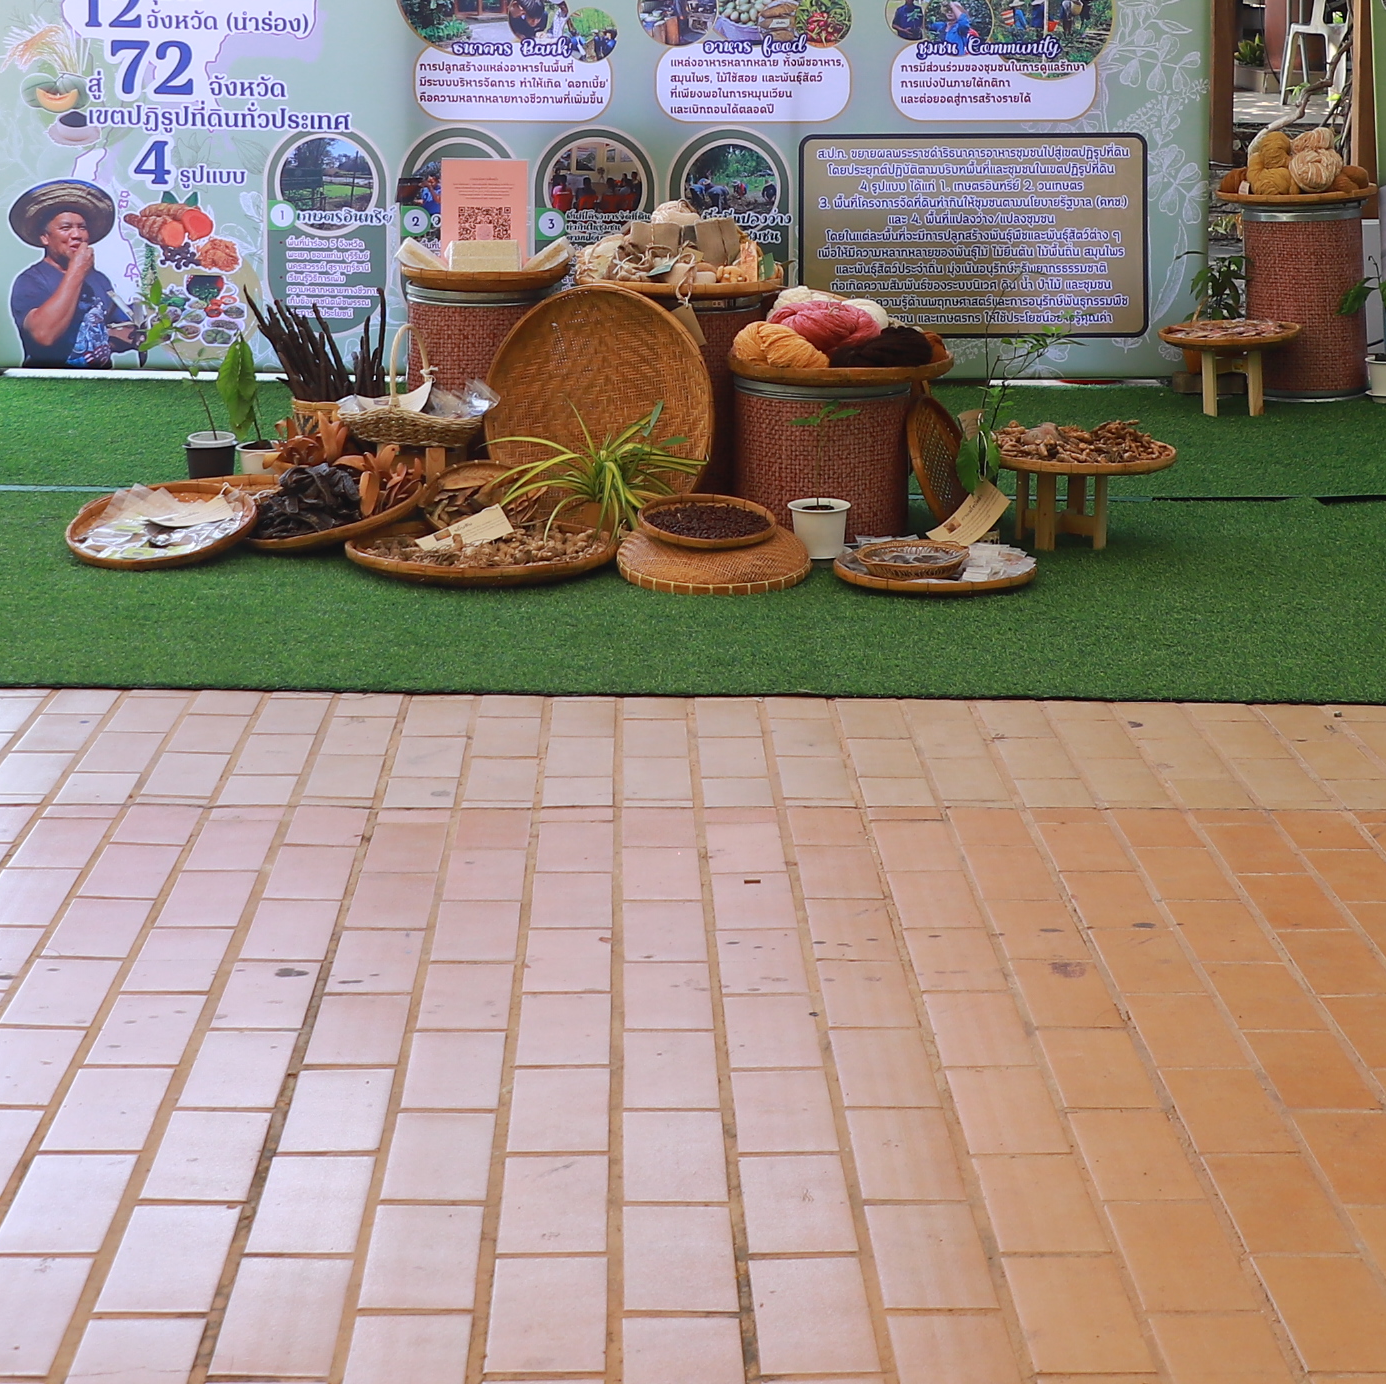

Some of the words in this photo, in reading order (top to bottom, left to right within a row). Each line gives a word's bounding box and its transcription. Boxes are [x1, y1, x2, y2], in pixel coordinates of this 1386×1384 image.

[146, 10, 218, 30] จังหวัด
[226, 12, 310, 34] (นำร่อง)
[451, 41, 514, 57] ธนาคาร
[520, 36, 573, 58] Bank
[703, 38, 753, 54] อาหาร
[761, 33, 808, 57] food
[916, 40, 960, 60] ชุมชน
[966, 35, 1062, 60] Community
[419, 59, 575, 75] การปลูกสร้างแหล่งอาหารในพื้นที่
[670, 56, 779, 68] แหล่งอาหารหลากหลาย
[900, 61, 1086, 77] การมีส่วนร่วมของชุมชนในการดูแลรักษา
[88, 71, 103, 101] สู่
[110, 39, 194, 96] 72
[208, 75, 287, 99] จังหวัด
[419, 76, 517, 88] มีระบบบริหารจัดการ
[519, 76, 562, 89] ทำให้เกิด
[716, 71, 759, 84] ไม้ใช้สอย
[762, 71, 824, 86] และพันธุ์สัตว์
[900, 77, 1011, 89] การแบ่งปันภายใต้กติกา
[419, 90, 605, 104] คือความหลากหลายทางชีวภาพที่เพิ่มขึ้น
[670, 86, 793, 101] ที่เพียงพอในการหมุนเวียน
[900, 92, 1032, 106] และต่อยอดสู่การสร้างรายได้
[670, 102, 775, 115] และเบิกถอนได้ตลอดปี
[88, 100, 351, 133] เขตปฏิรูปที่ดินทั่วประเทศ
[816, 146, 847, 159] ส.ป.ก.
[134, 140, 172, 185] 4
[179, 166, 246, 185] รูปแบบ
[859, 180, 868, 192] 4
[871, 180, 906, 194] รูปแบบ
[909, 180, 936, 192] ได้แก่
[953, 179, 1021, 192] เกษตรอินทรีย์
[1038, 181, 1084, 191] วนเกษตร
[819, 198, 830, 209] 3.
[280, 210, 285, 220] 1
[296, 207, 396, 225] เกษตรอินทรีย์
[411, 216, 420, 226] 2
[888, 214, 908, 224] และ
[911, 213, 922, 224] 4.
[547, 218, 555, 230] 3
[1083, 246, 1125, 259] สมุนไพร
[1065, 279, 1112, 293] และชุมชน
[917, 312, 981, 324] และเกษตรกร
